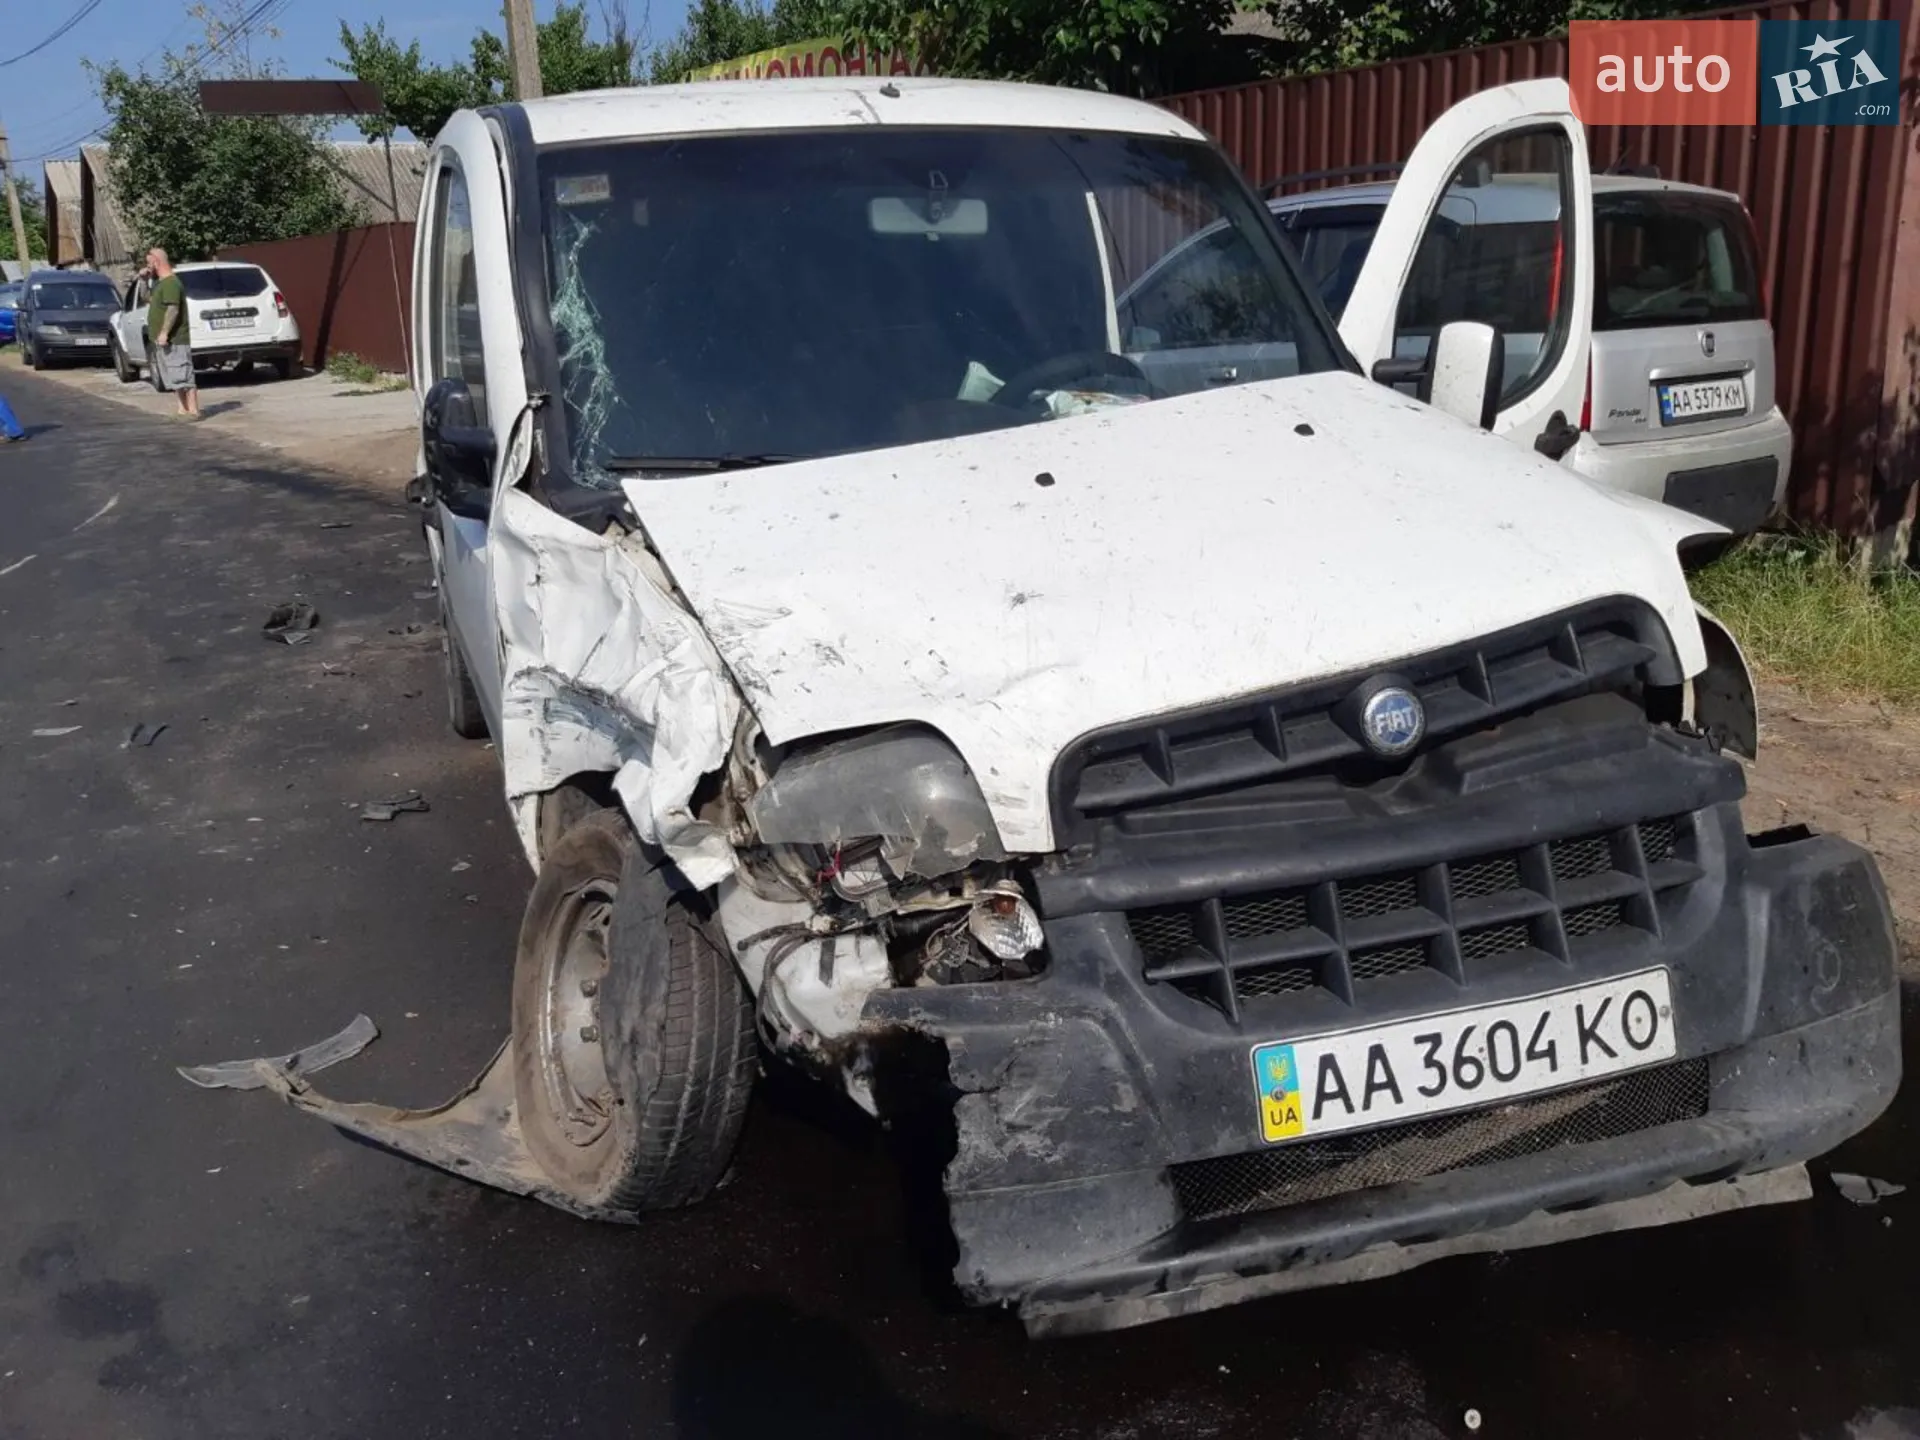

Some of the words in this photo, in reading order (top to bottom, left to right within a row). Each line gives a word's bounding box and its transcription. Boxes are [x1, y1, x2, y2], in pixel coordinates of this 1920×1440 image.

[1694, 386, 1722, 410] 5379
[1375, 706, 1412, 735] FIAT
[1312, 1043, 1403, 1120] AA
[1414, 1011, 1558, 1097] 3604
[1576, 990, 1658, 1065] KO
[1270, 1107, 1298, 1126] UA
